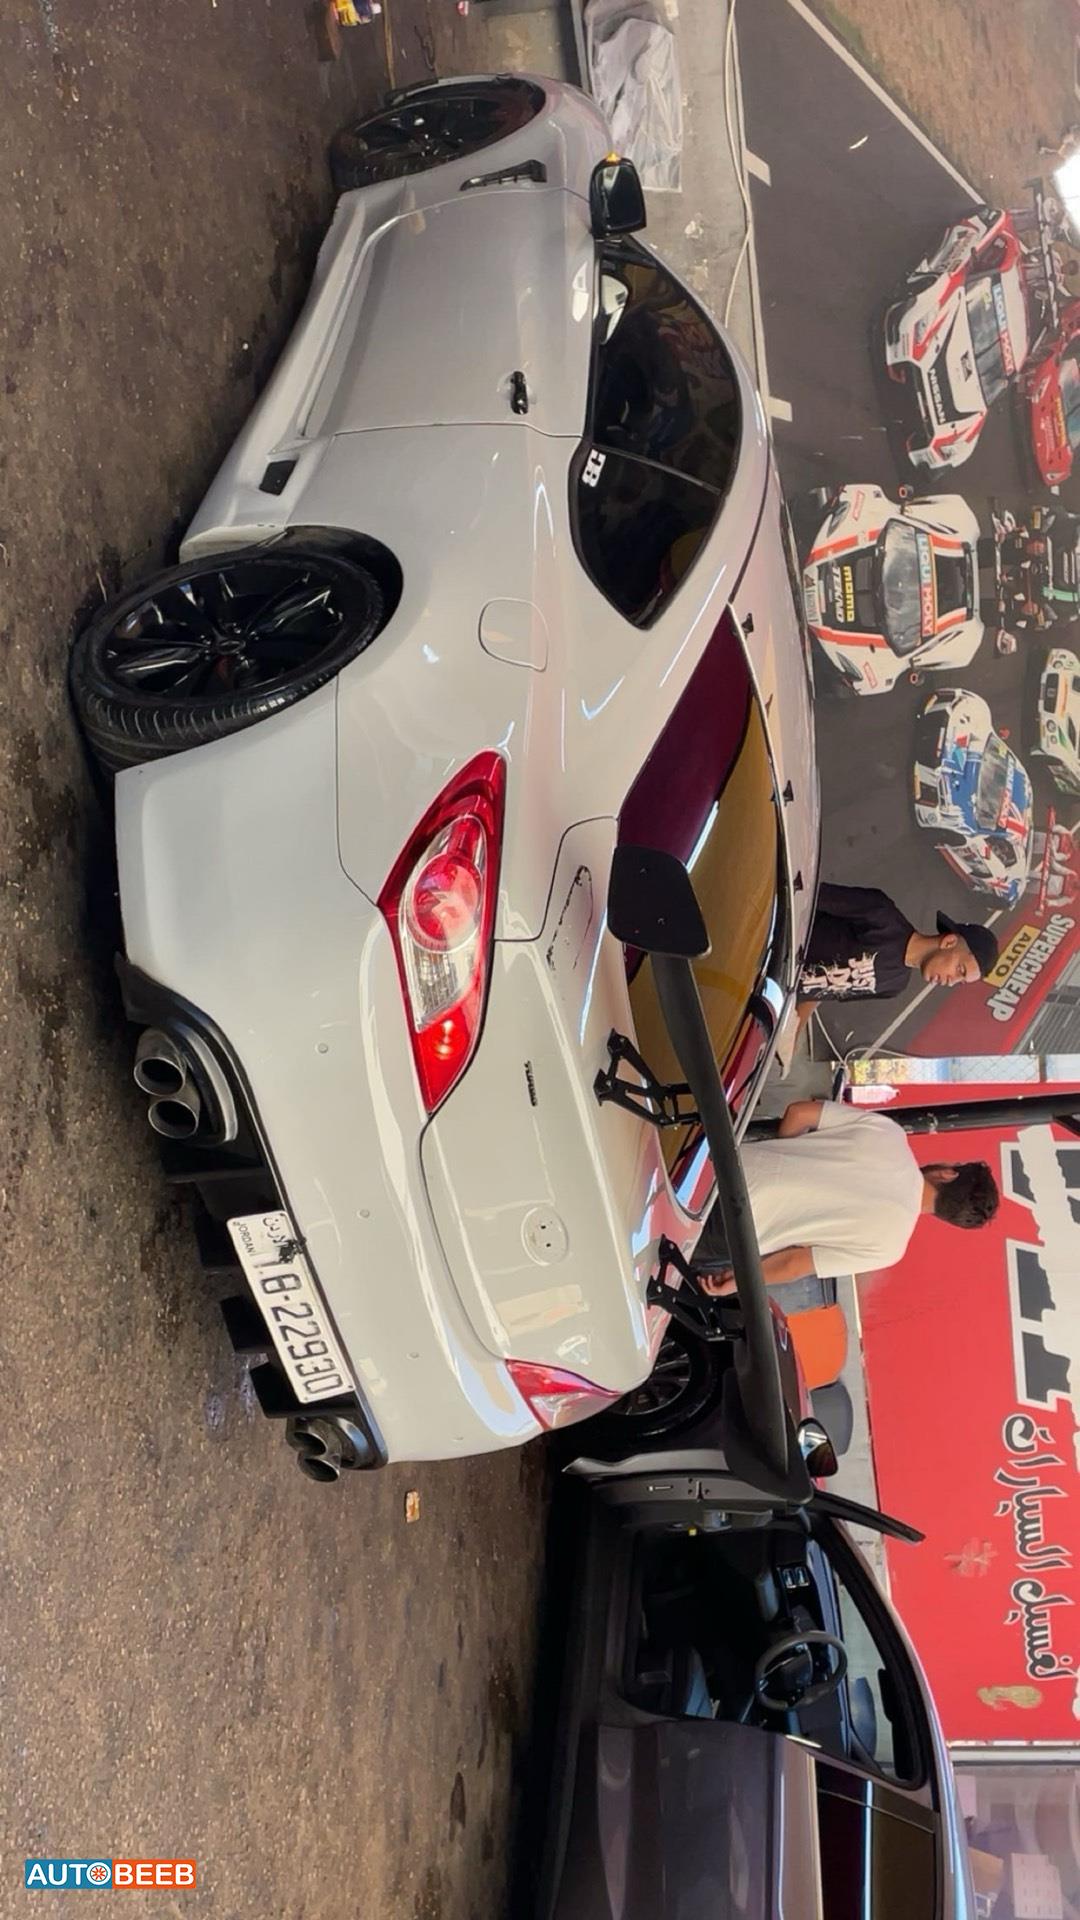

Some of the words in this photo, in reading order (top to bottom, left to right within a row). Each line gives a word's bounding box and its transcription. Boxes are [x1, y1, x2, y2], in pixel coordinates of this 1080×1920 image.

[929, 368, 946, 424] NISSAN
[832, 566, 844, 623] TEKNO
[922, 586, 933, 635] MOLY
[848, 957, 876, 992] JUST
[986, 914, 1075, 1022] SUPERCHEAP
[994, 932, 1032, 978] AUTO
[238, 1222, 256, 1254] JORDAN
[993, 1413, 1073, 1572] السيارات
[1003, 1578, 1076, 1680] لغسيل
